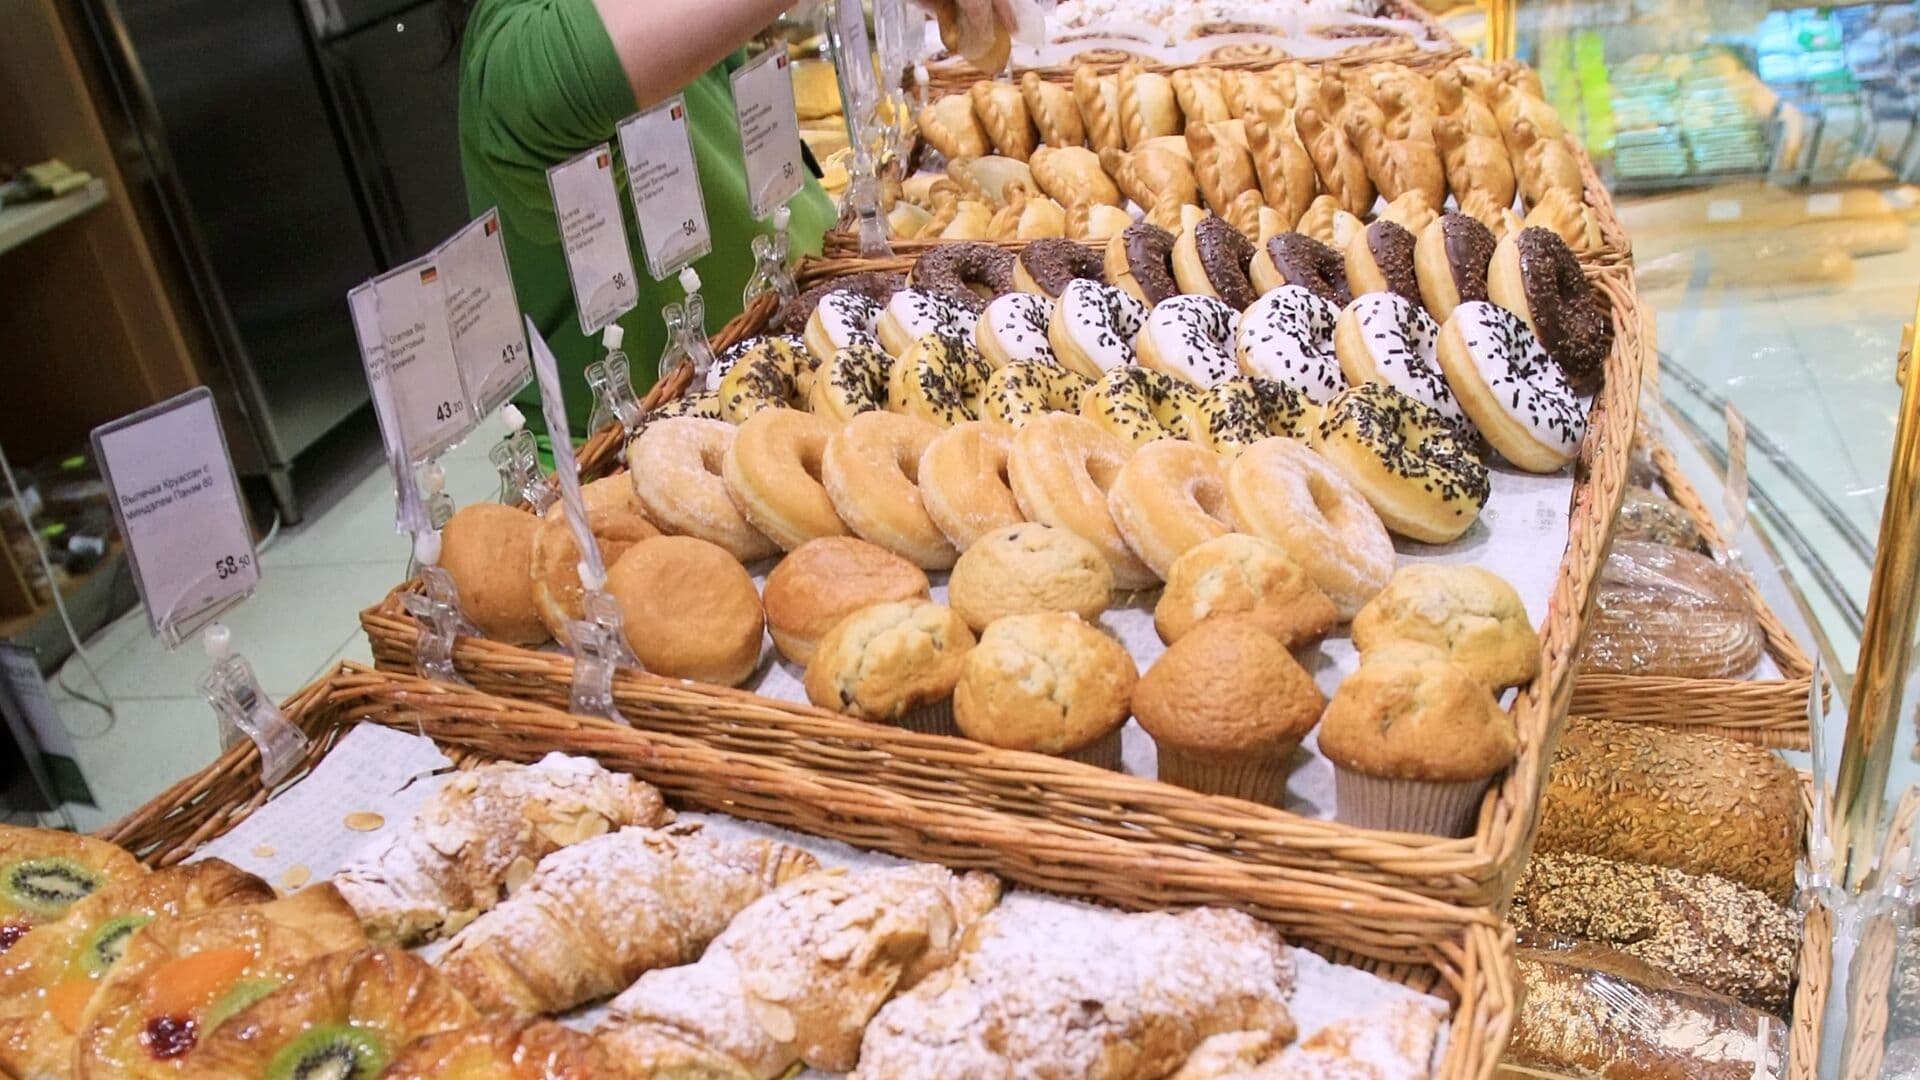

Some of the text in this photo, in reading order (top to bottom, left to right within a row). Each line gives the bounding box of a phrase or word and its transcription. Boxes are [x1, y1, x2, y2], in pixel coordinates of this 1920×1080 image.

[682, 218, 697, 236] 50
[612, 272, 627, 290] 50
[502, 344, 516, 364] 43
[437, 401, 452, 421] 43
[121, 484, 162, 506] Выпечка
[216, 555, 238, 580] 58
